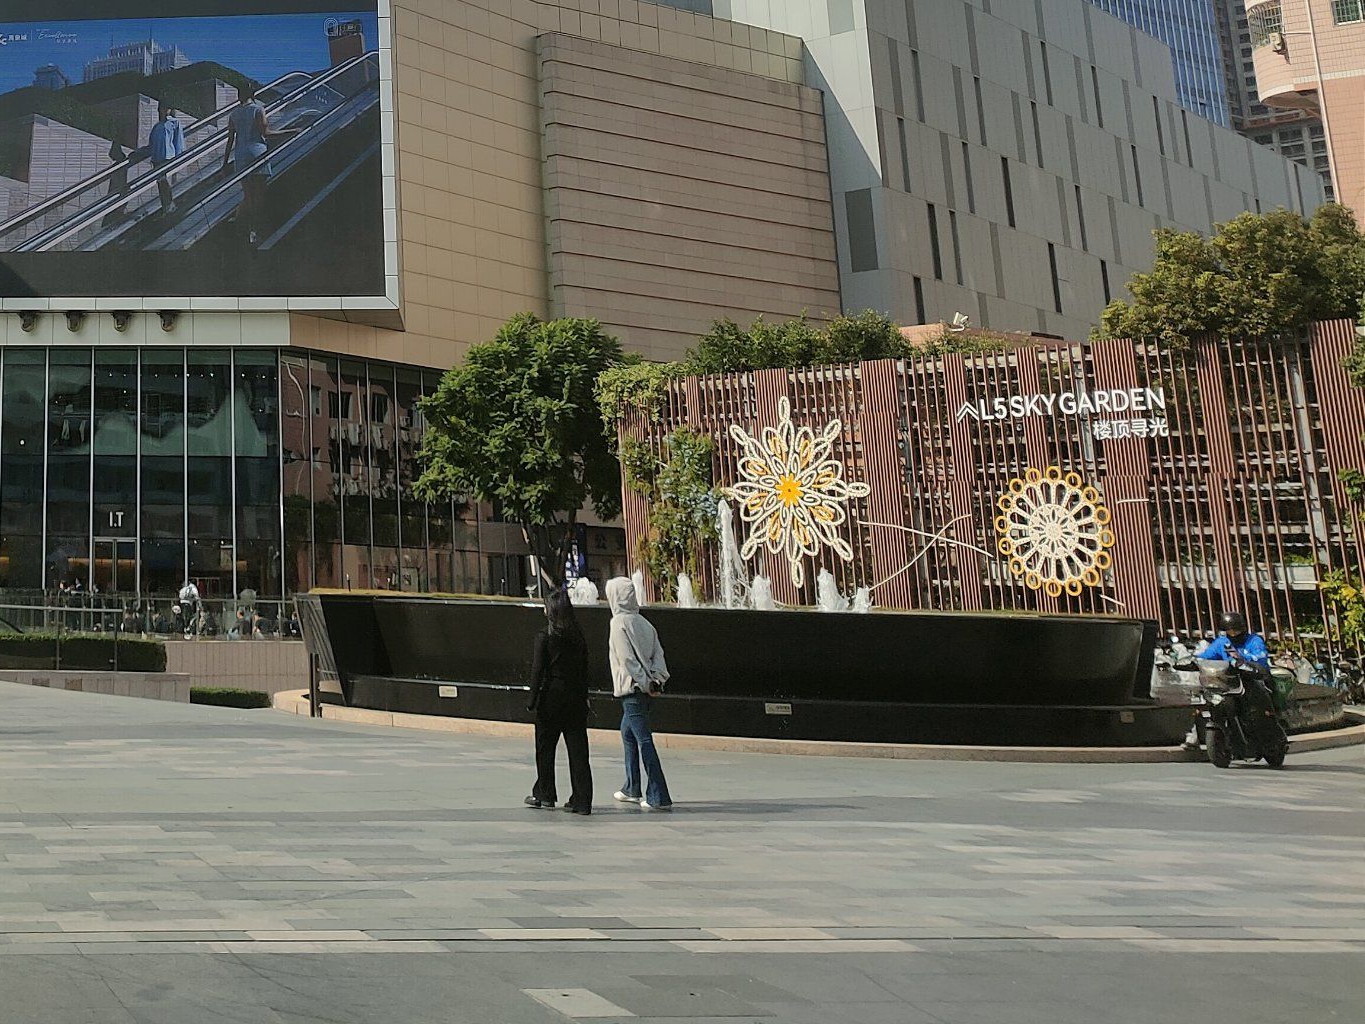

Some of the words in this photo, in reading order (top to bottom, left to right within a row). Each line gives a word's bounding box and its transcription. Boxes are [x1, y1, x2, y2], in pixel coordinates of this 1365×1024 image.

[980, 397, 1008, 420] L5
[1010, 393, 1056, 418] SKY
[1058, 387, 1166, 415] GARDEN
[1092, 418, 1169, 441] 楼顶寻光
